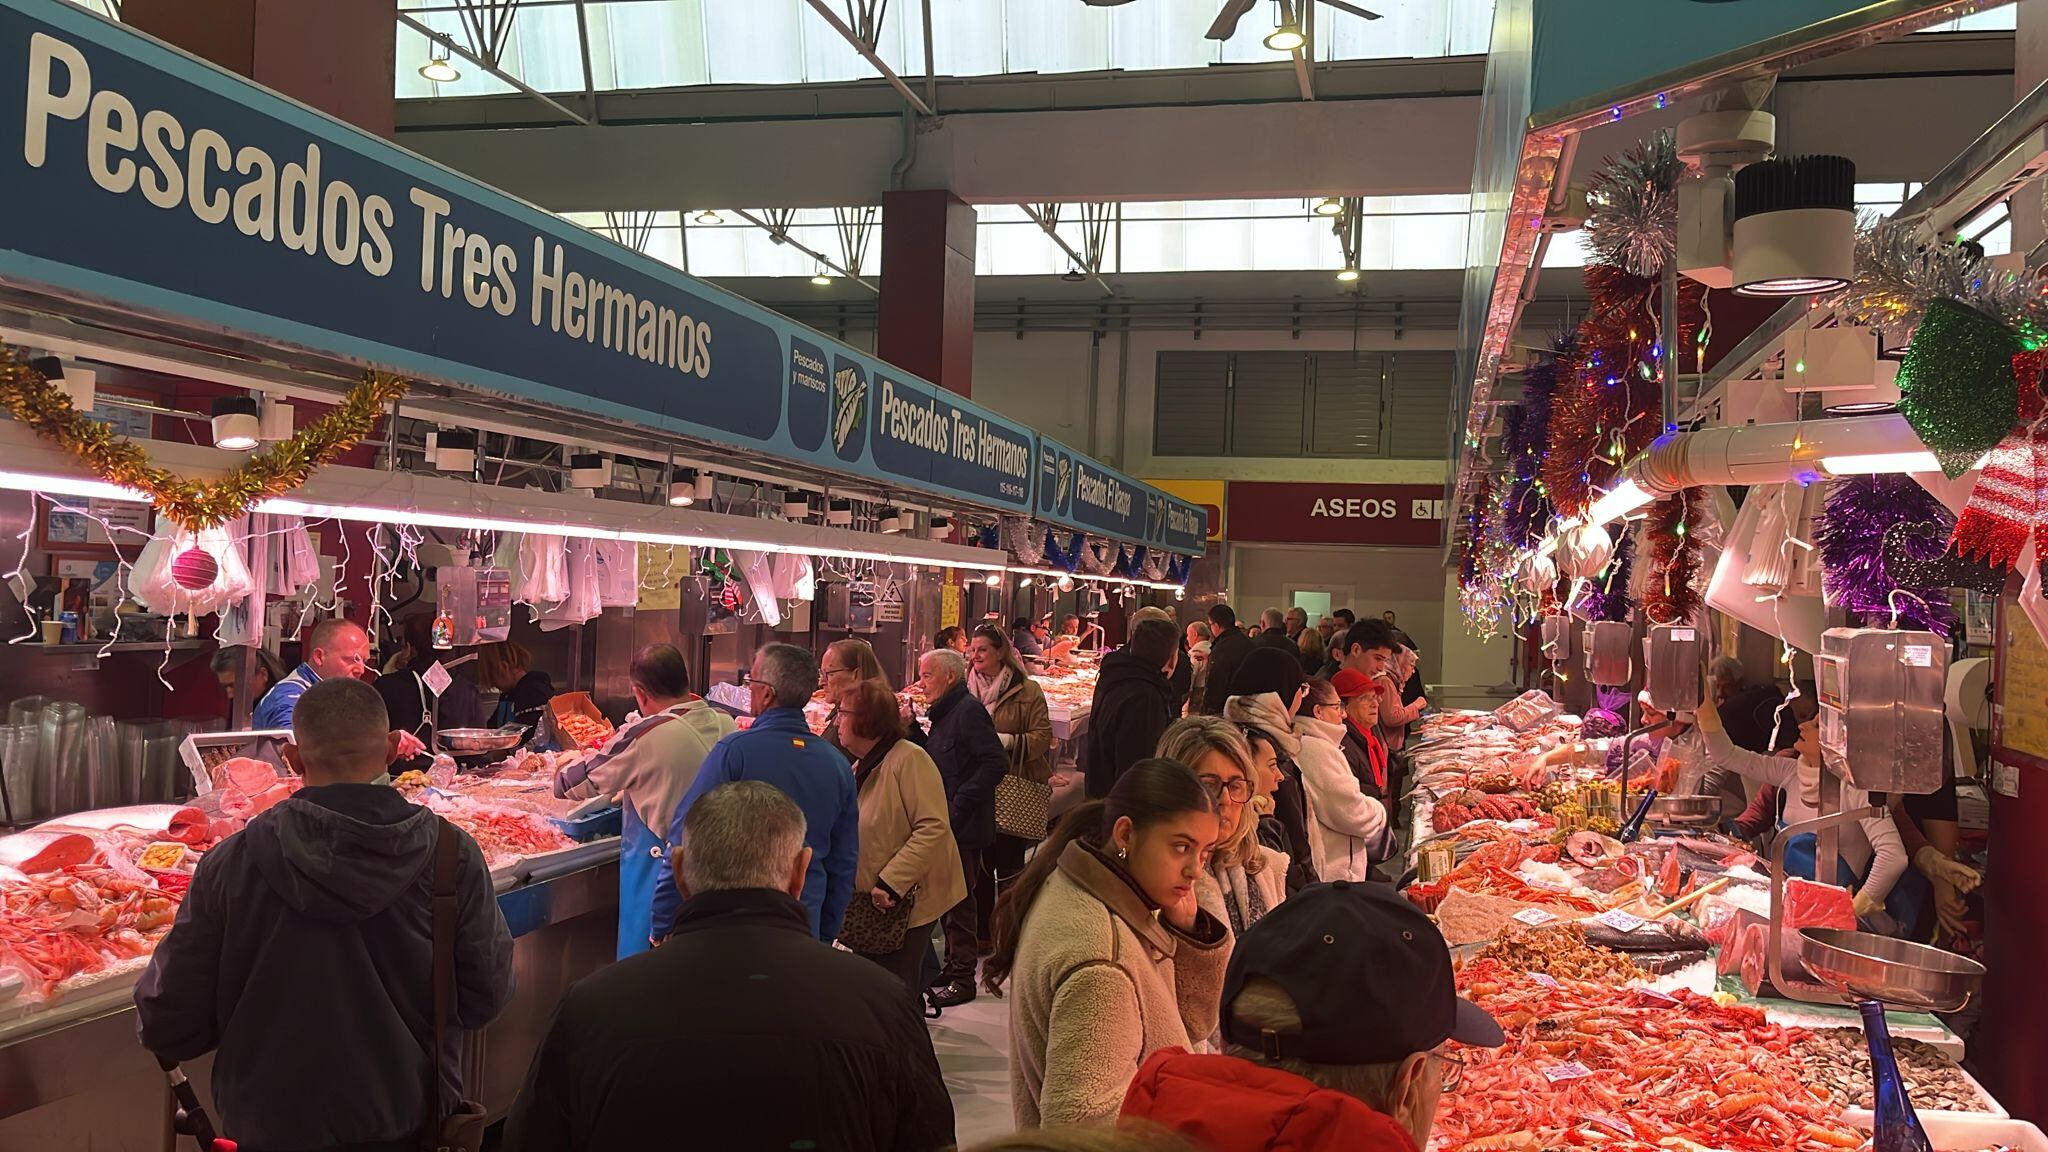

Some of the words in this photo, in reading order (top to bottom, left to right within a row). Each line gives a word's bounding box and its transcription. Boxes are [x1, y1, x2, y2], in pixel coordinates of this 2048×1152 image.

[25, 32, 393, 277] Pescados
[410, 187, 517, 316] Tres
[531, 236, 711, 379] Hermanos
[793, 349, 824, 375] Pescados
[792, 371, 798, 385] y
[798, 373, 826, 393] mariscos
[880, 380, 948, 455] Pescados
[951, 408, 976, 463] Tres
[977, 419, 1028, 479] Hermanos
[1076, 464, 1107, 509] Pescados
[1106, 478, 1115, 511] El
[1310, 498, 1397, 519] ASEOS
